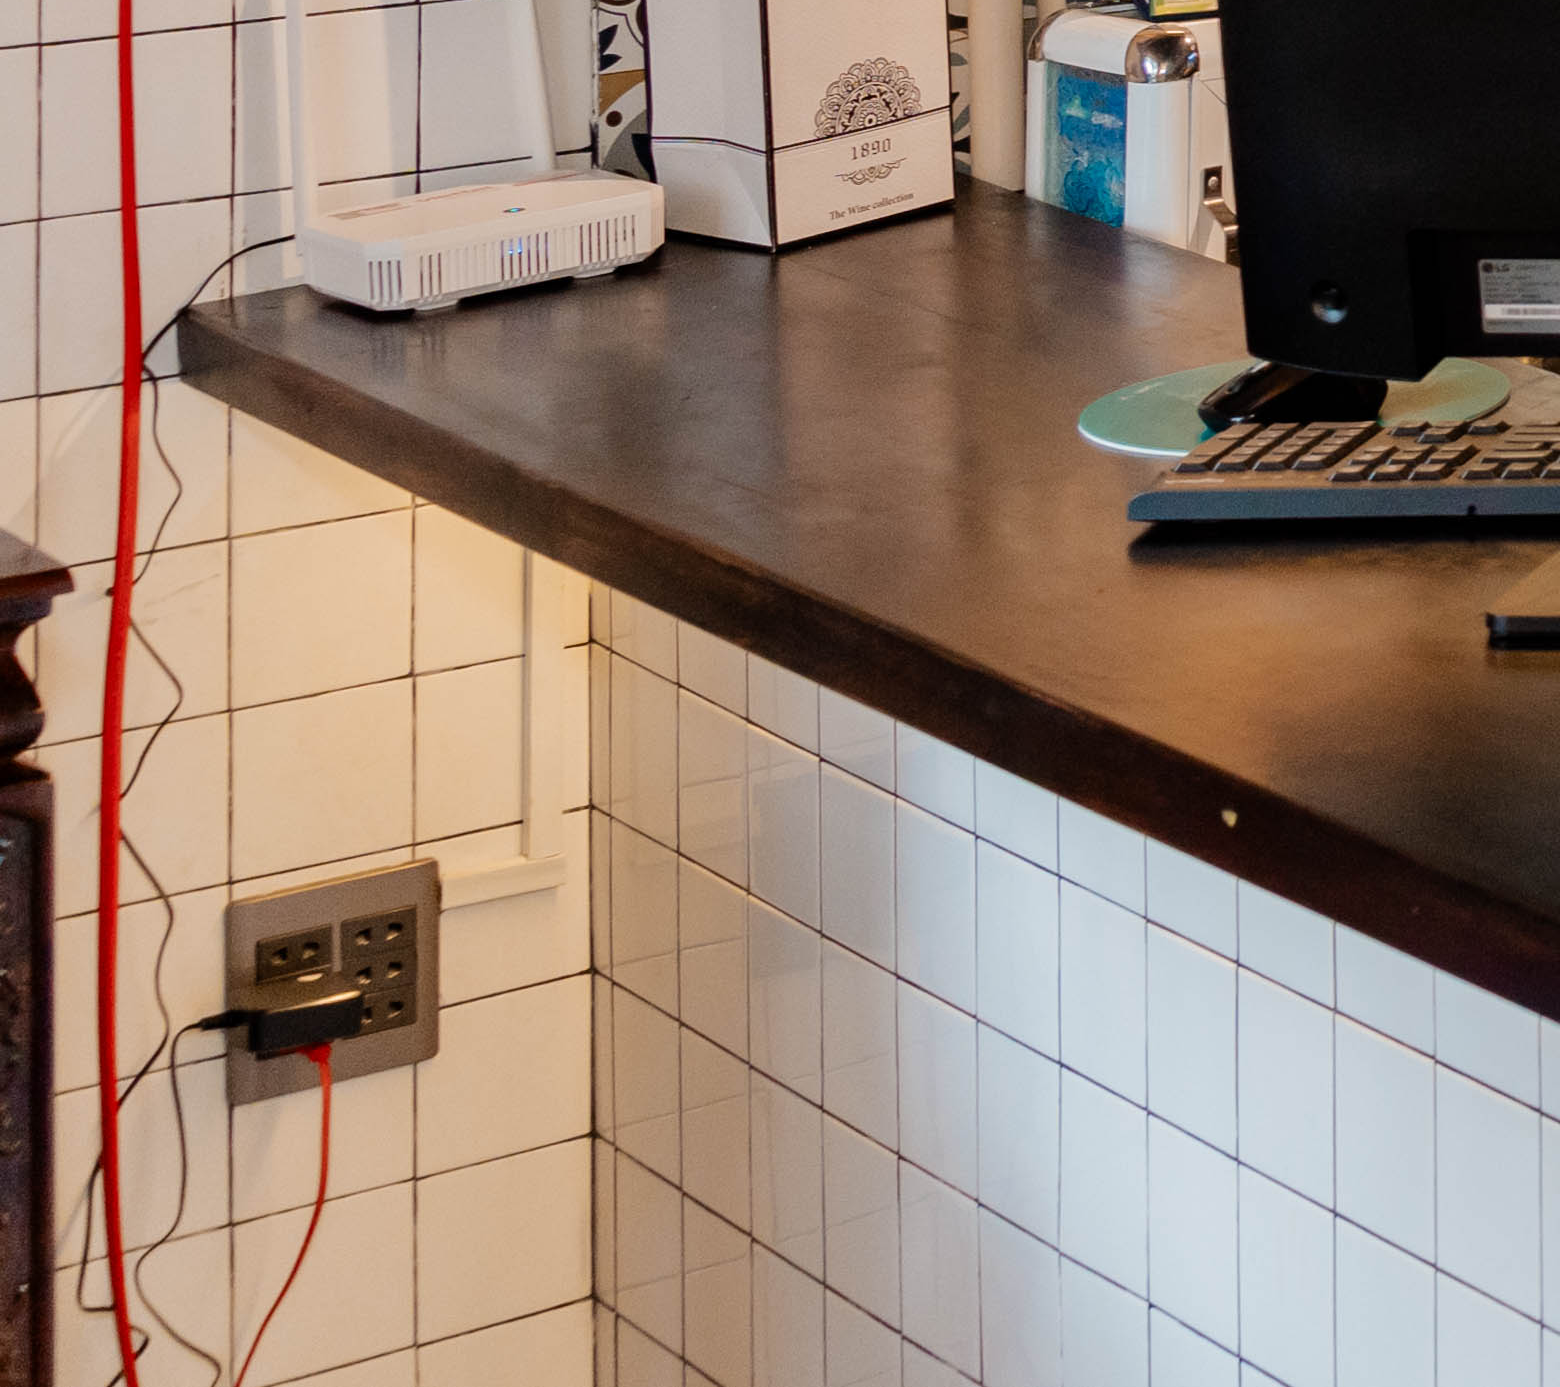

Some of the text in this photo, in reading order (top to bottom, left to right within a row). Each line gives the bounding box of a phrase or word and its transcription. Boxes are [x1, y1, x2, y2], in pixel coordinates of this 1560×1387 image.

[851, 138, 892, 161] 1890
[829, 192, 915, 220] The Wine collection
